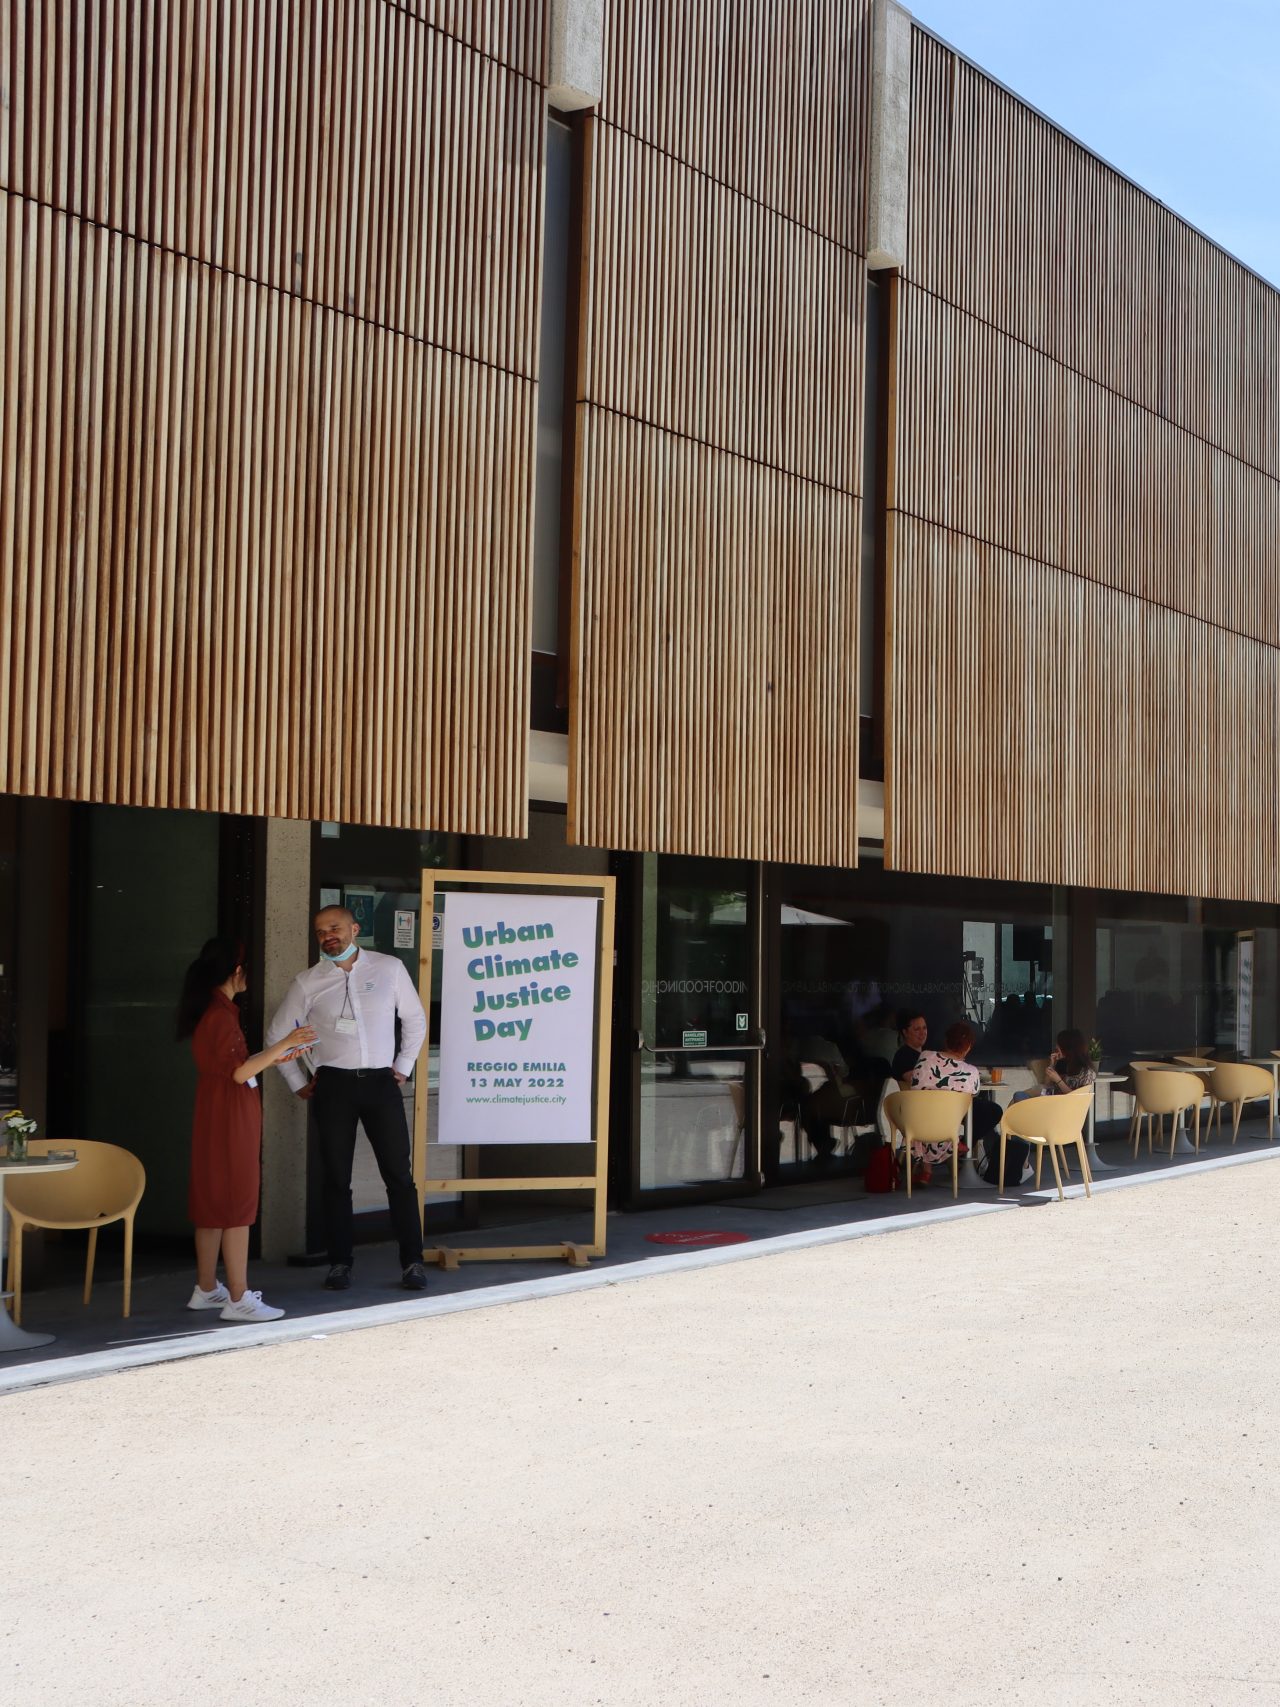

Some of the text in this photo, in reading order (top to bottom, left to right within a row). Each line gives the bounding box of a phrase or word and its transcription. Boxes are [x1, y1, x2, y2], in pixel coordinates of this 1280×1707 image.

[462, 921, 554, 949] Urban
[467, 949, 579, 981] Climate
[472, 981, 571, 1013] Justice
[474, 1018, 533, 1042] Day
[467, 1062, 567, 1072] REGGIO EMILIA
[470, 1078, 565, 1088] 13 MAY 2022
[466, 1094, 567, 1105] www.climatejustice.city
